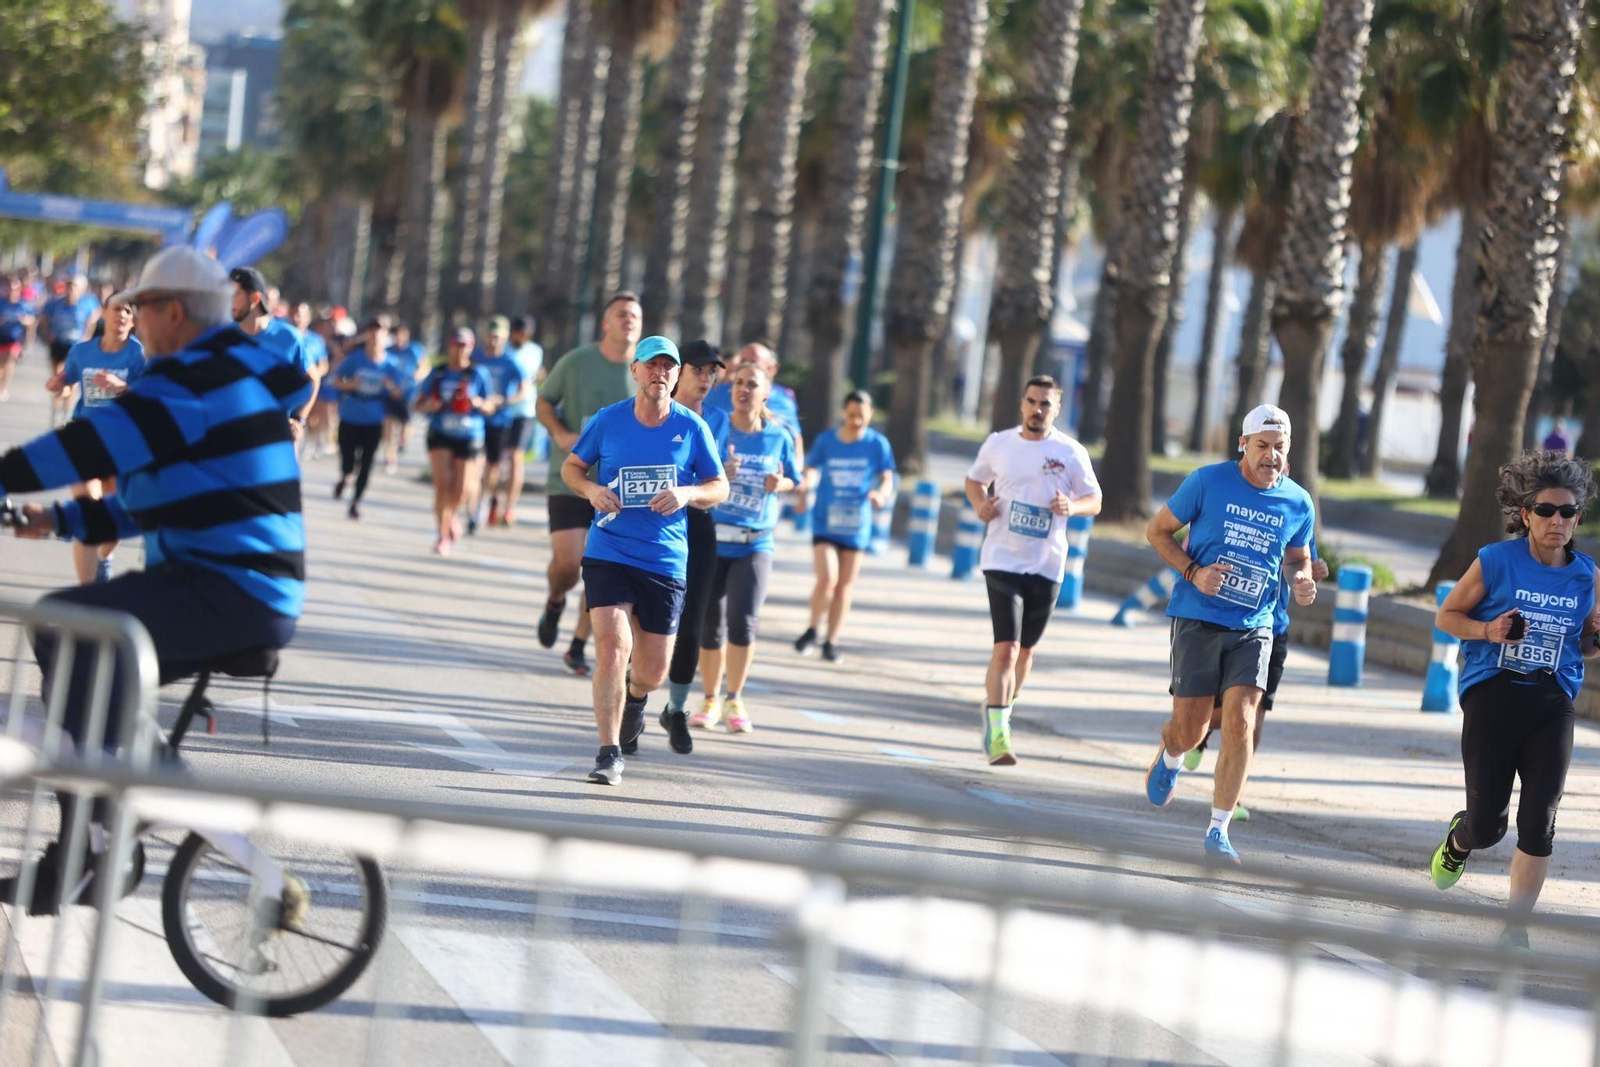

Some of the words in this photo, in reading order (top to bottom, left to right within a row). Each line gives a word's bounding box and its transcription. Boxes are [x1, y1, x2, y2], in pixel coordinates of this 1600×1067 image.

[1012, 513, 1047, 529] 2065
[1226, 503, 1285, 528] mayoral
[1223, 520, 1278, 543] RUNNING
[1227, 529, 1271, 547] MAKES
[1224, 536, 1269, 555] FRIENDS
[1515, 589, 1578, 610] mayoral
[1524, 620, 1568, 634] AKES
[1510, 644, 1553, 663] 1856
